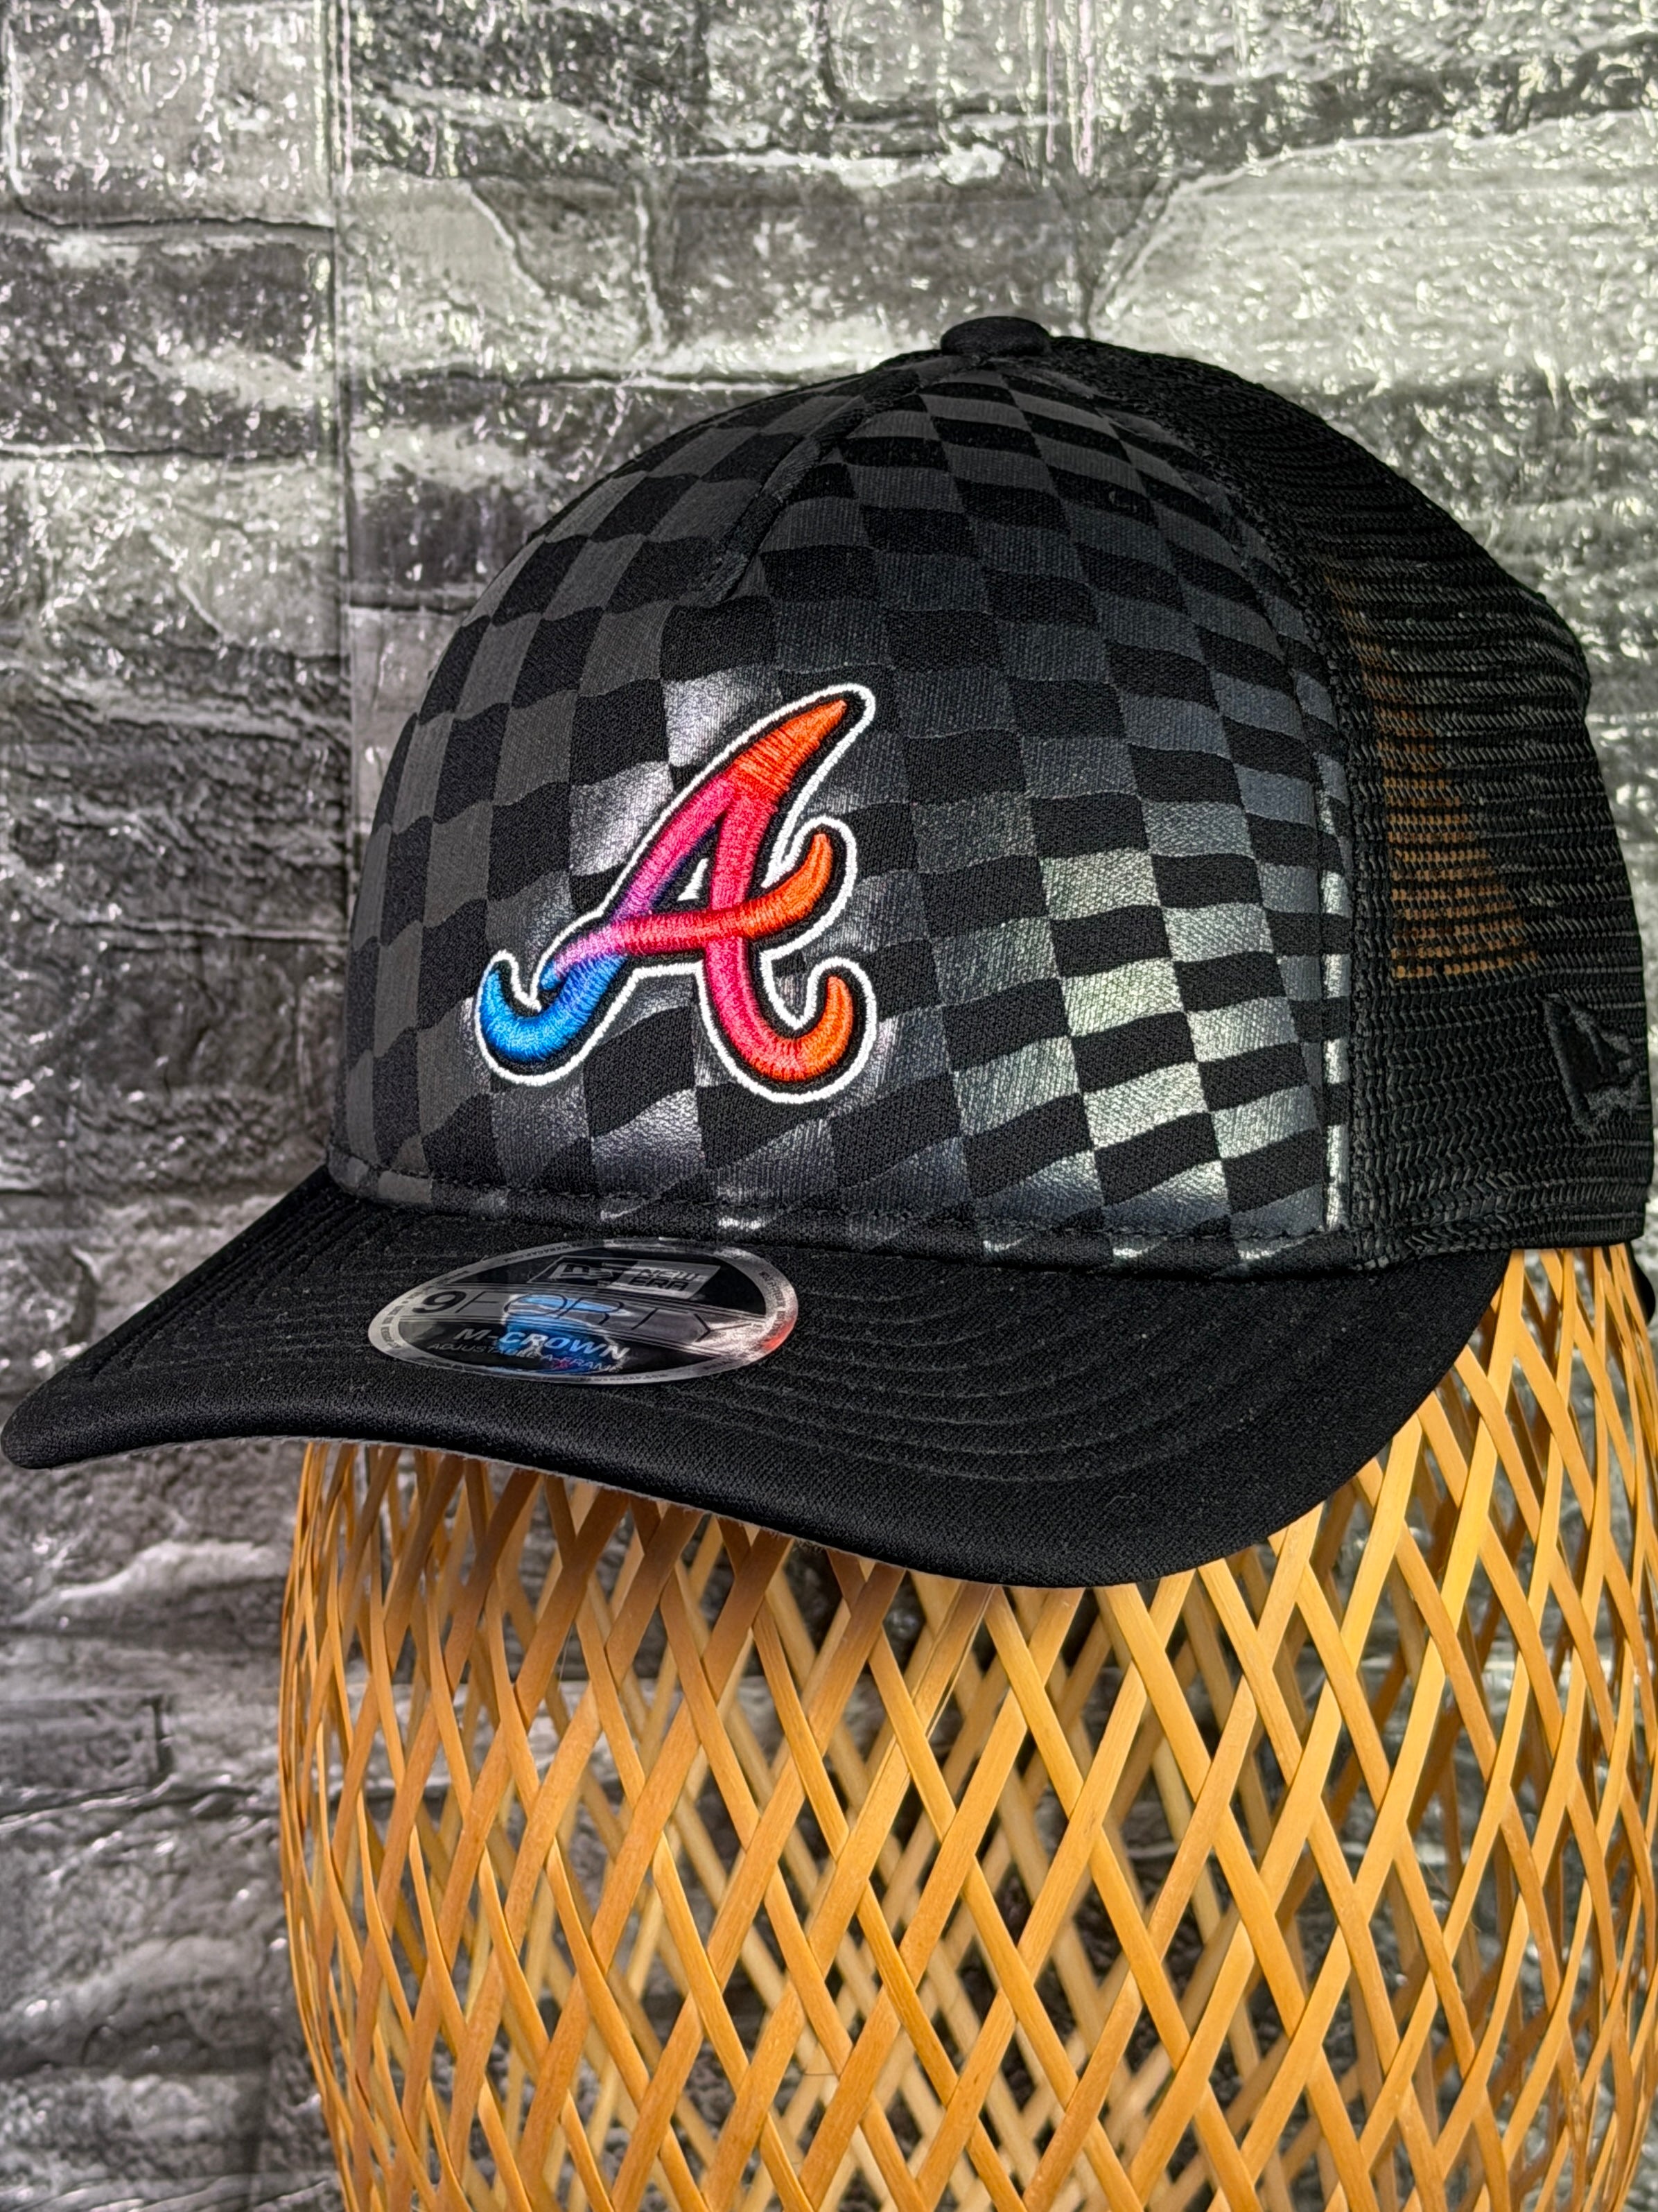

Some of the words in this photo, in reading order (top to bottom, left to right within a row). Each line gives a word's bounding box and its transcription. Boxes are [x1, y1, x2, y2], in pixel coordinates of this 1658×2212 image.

[475, 683, 875, 1103] A
[629, 1276, 688, 1291] ERA
[638, 1269, 704, 1281] NEW
[412, 1291, 752, 1343] 9FORTY
[453, 1327, 630, 1360] M-CROWN
